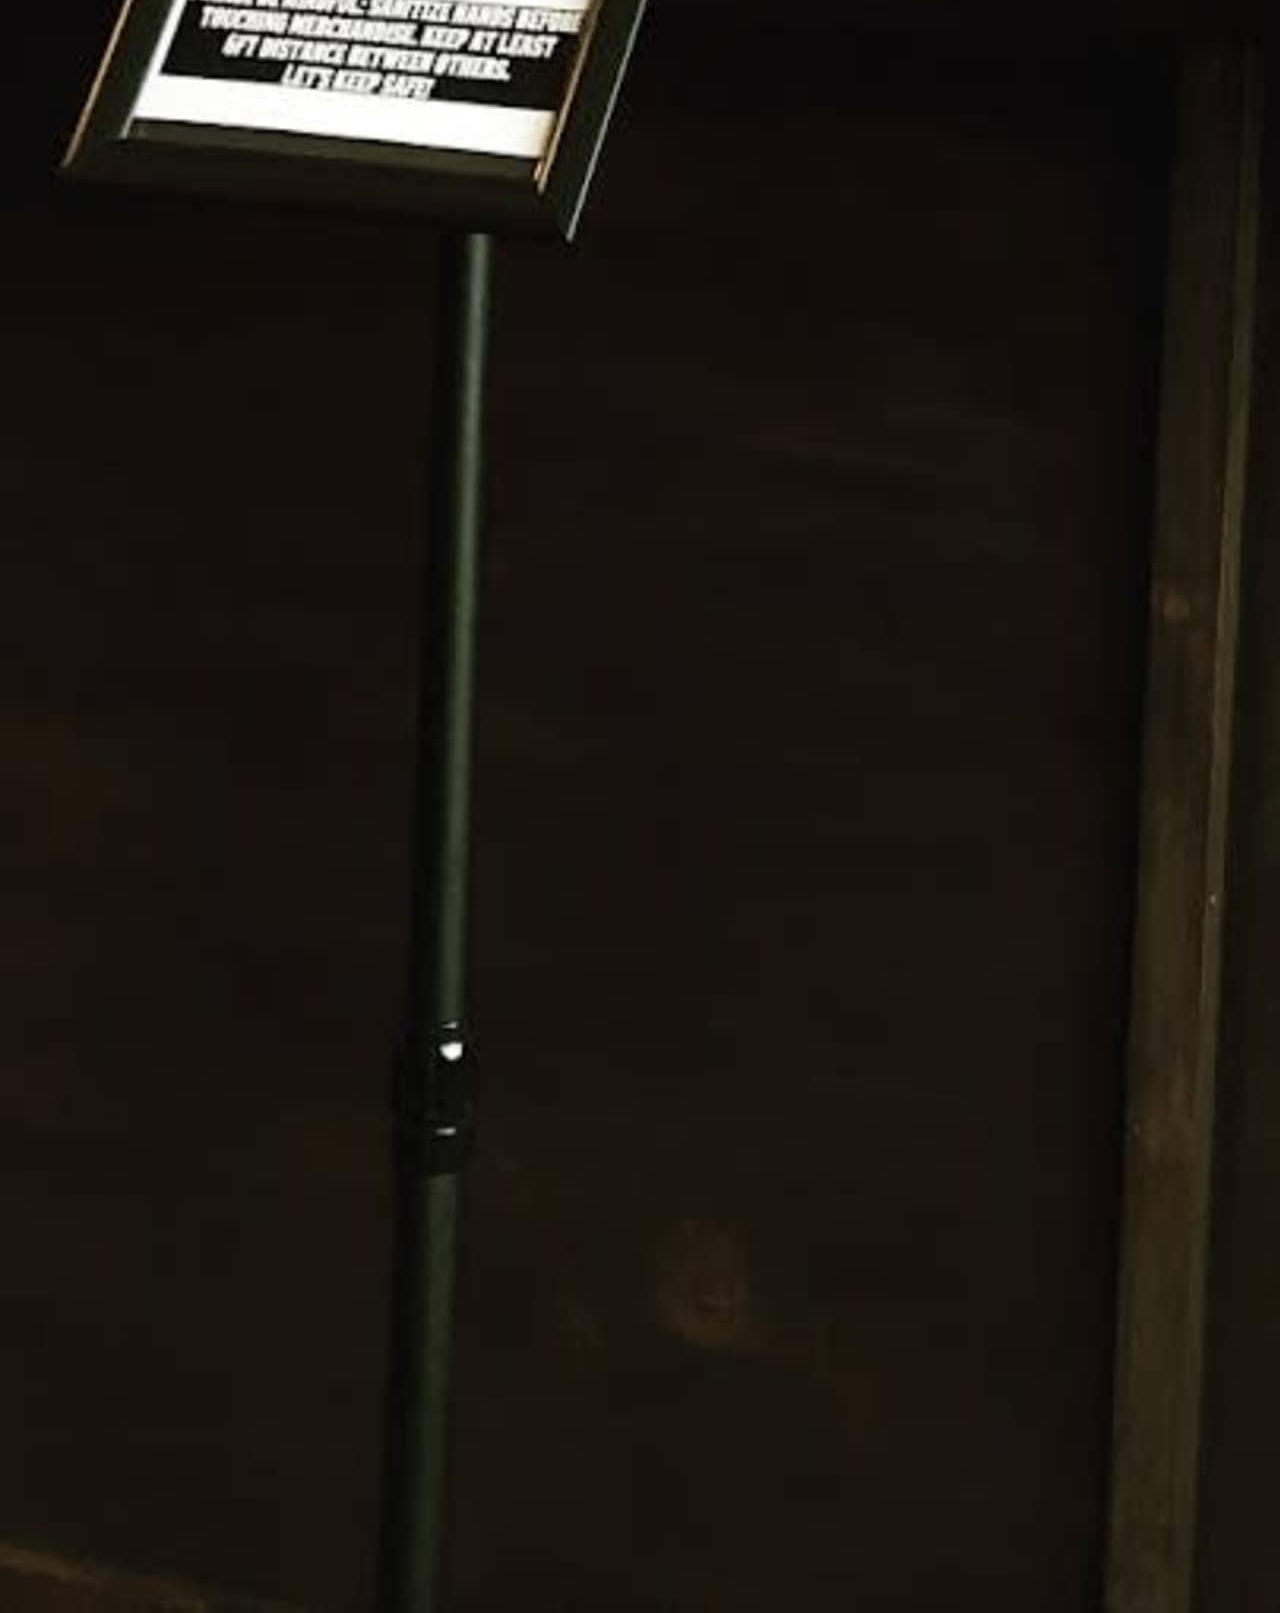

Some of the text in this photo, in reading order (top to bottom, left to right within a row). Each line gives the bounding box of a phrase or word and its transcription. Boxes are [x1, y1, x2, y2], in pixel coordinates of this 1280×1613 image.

[201, 5, 289, 34] TOUCHING
[420, 24, 470, 51] KEEP
[469, 30, 498, 54] AT
[496, 32, 558, 59] LEAST
[452, 3, 516, 29] HANDS
[259, 37, 349, 67] DISTANCE
[347, 43, 435, 74] BETWEEN
[331, 68, 383, 95] KEEP
